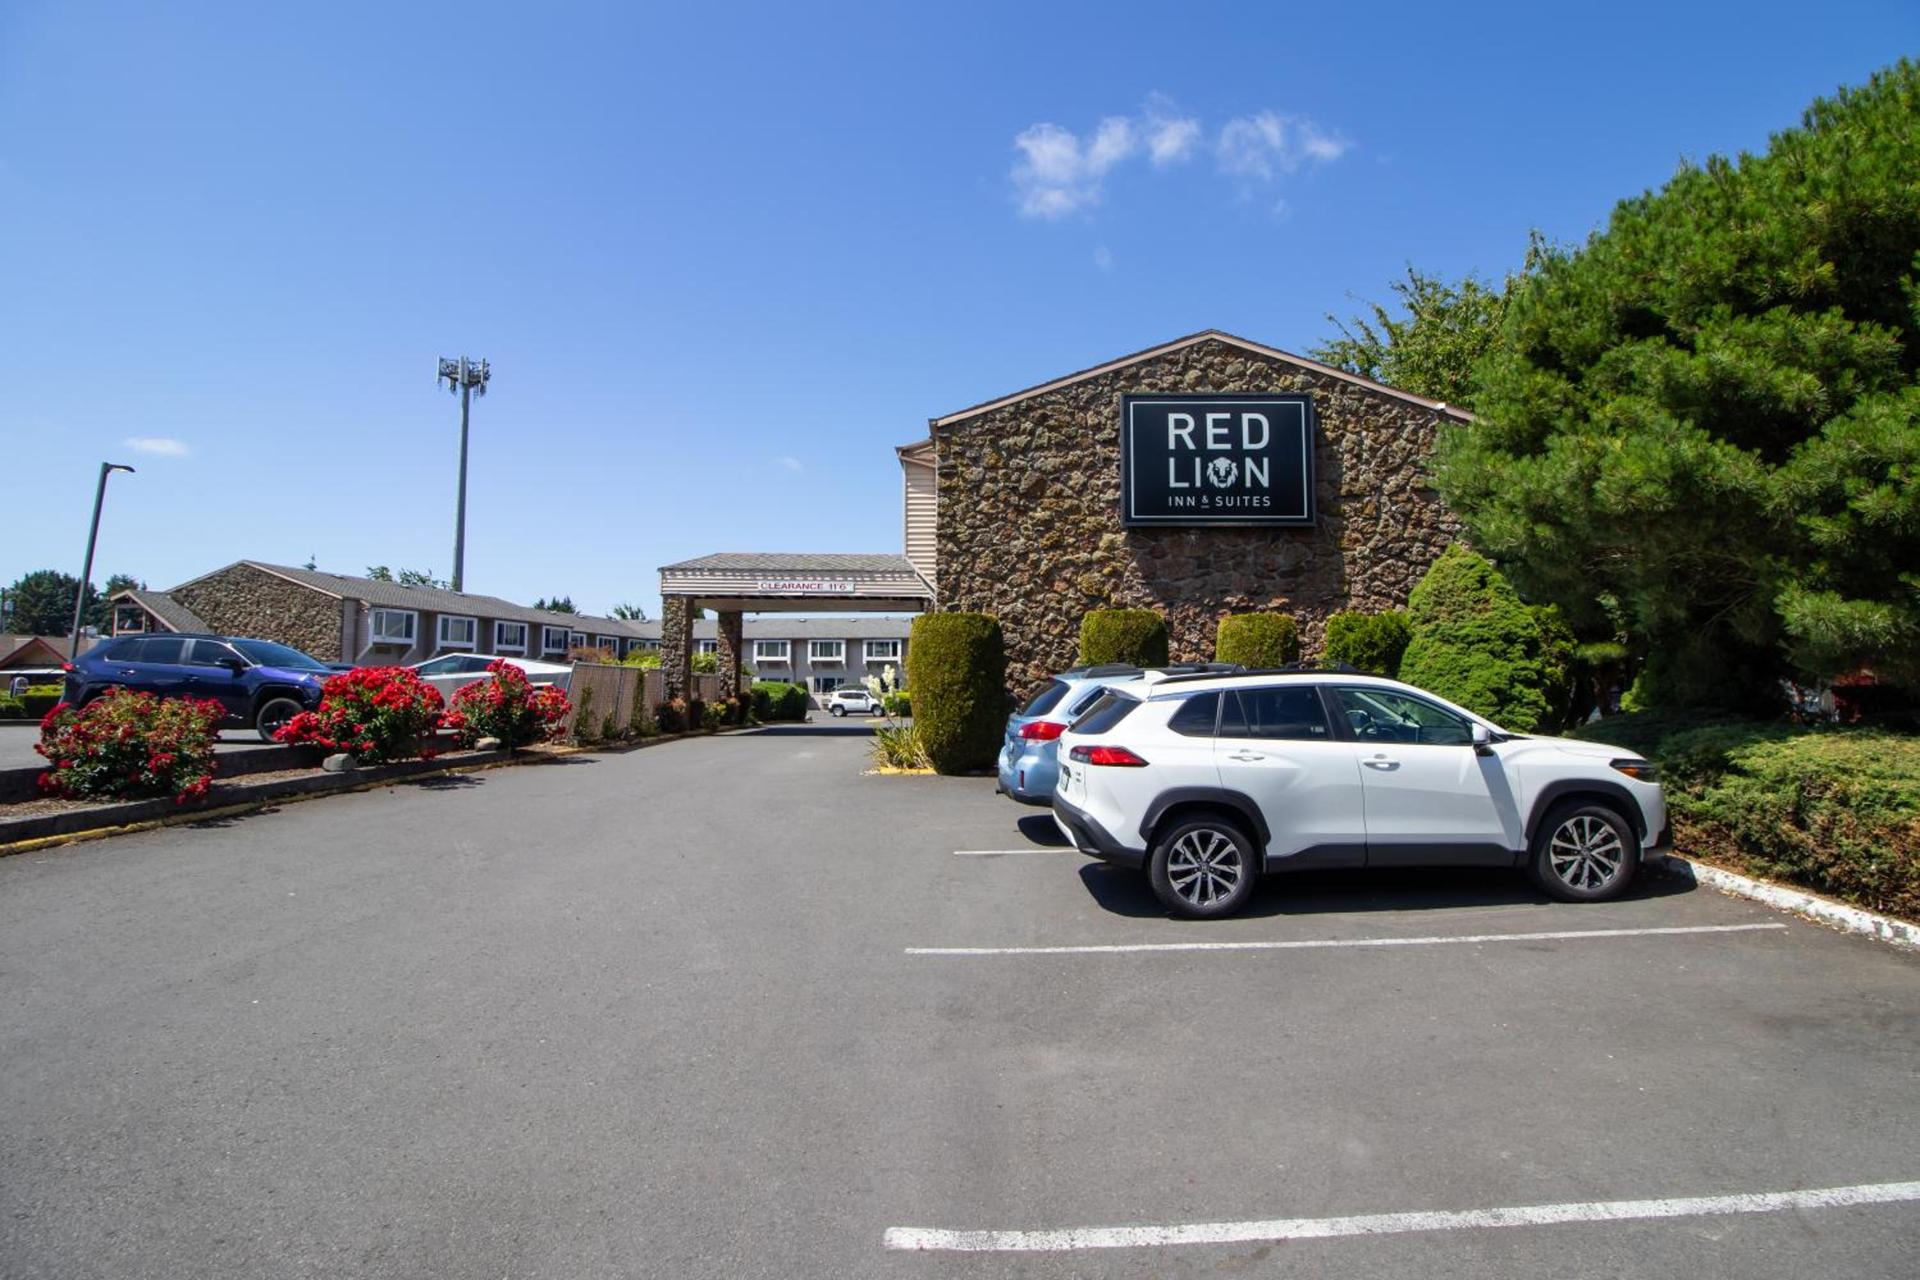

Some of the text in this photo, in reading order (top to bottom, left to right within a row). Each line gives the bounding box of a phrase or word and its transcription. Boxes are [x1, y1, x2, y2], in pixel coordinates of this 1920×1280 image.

[1168, 413, 1270, 450] RED
[1168, 495, 1271, 508] INN & SUITES
[760, 582, 823, 590] CLEARANCE
